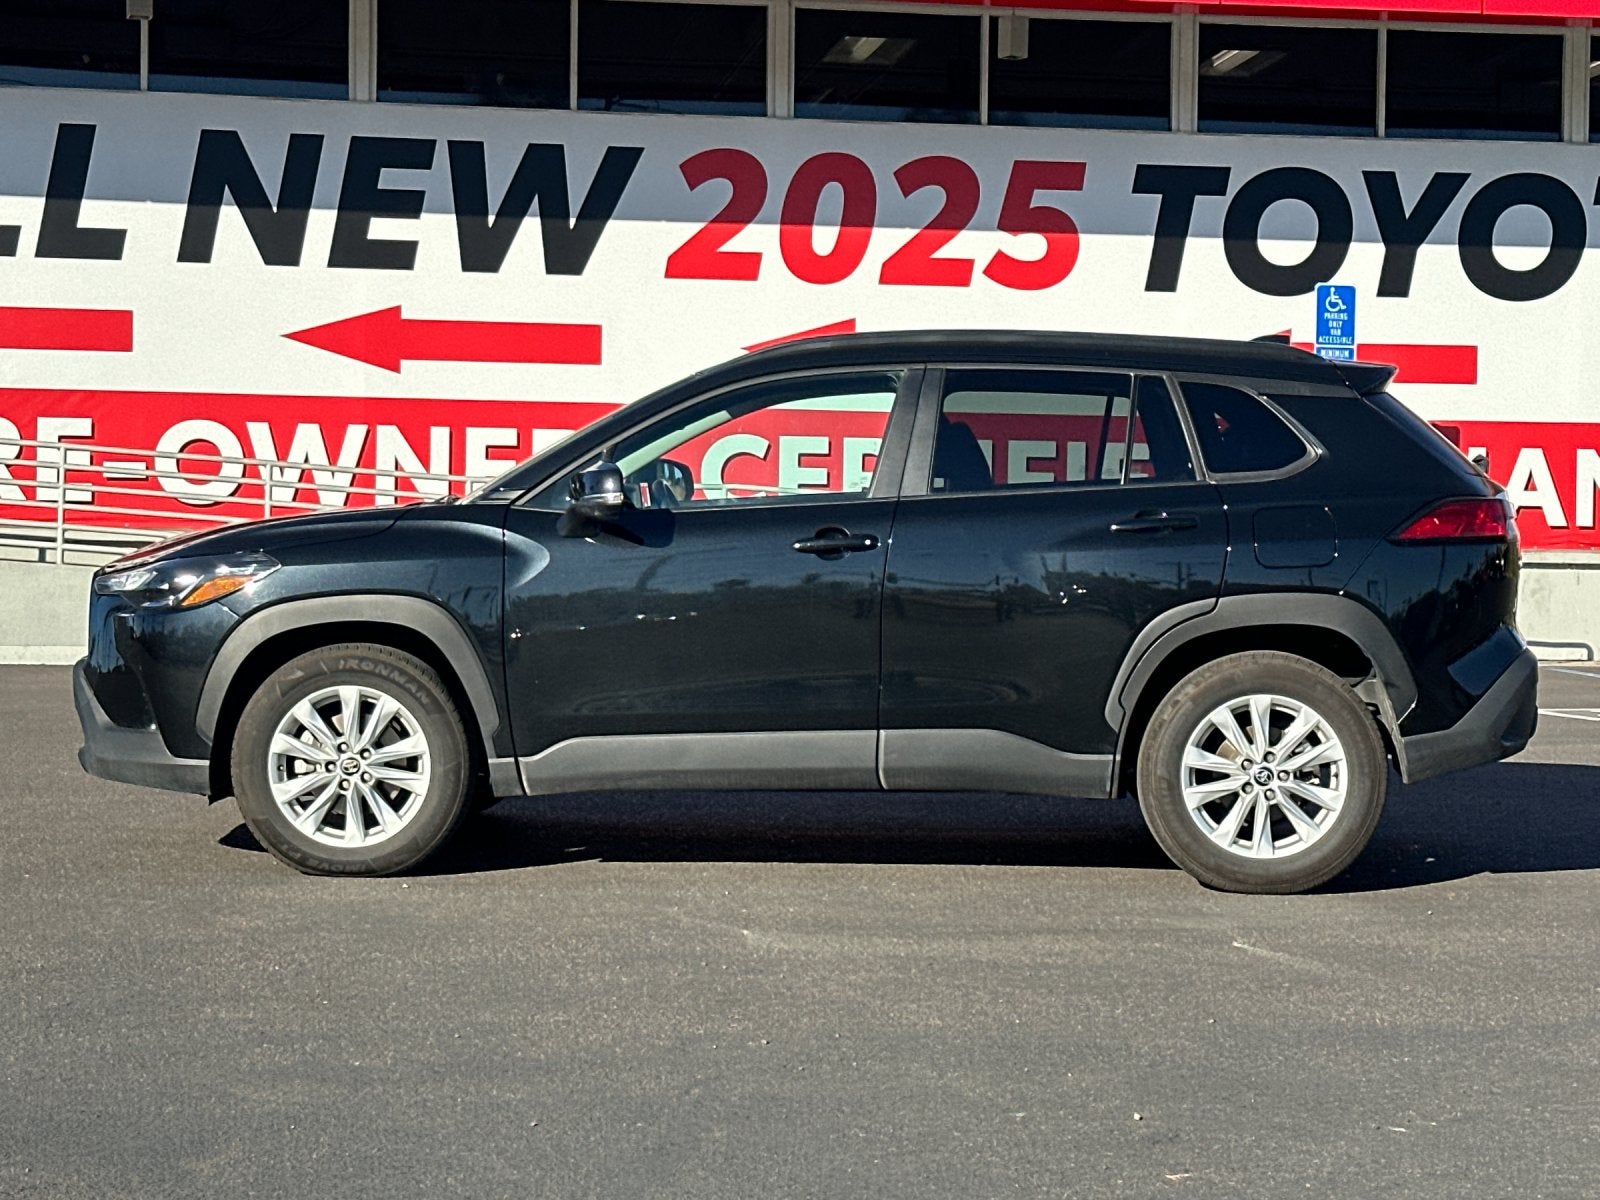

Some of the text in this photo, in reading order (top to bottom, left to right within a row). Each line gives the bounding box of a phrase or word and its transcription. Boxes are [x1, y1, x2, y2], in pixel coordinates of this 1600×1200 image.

[0, 123, 1600, 302] L NEW 2025 TOYO
[1328, 320, 1343, 328] ONLY
